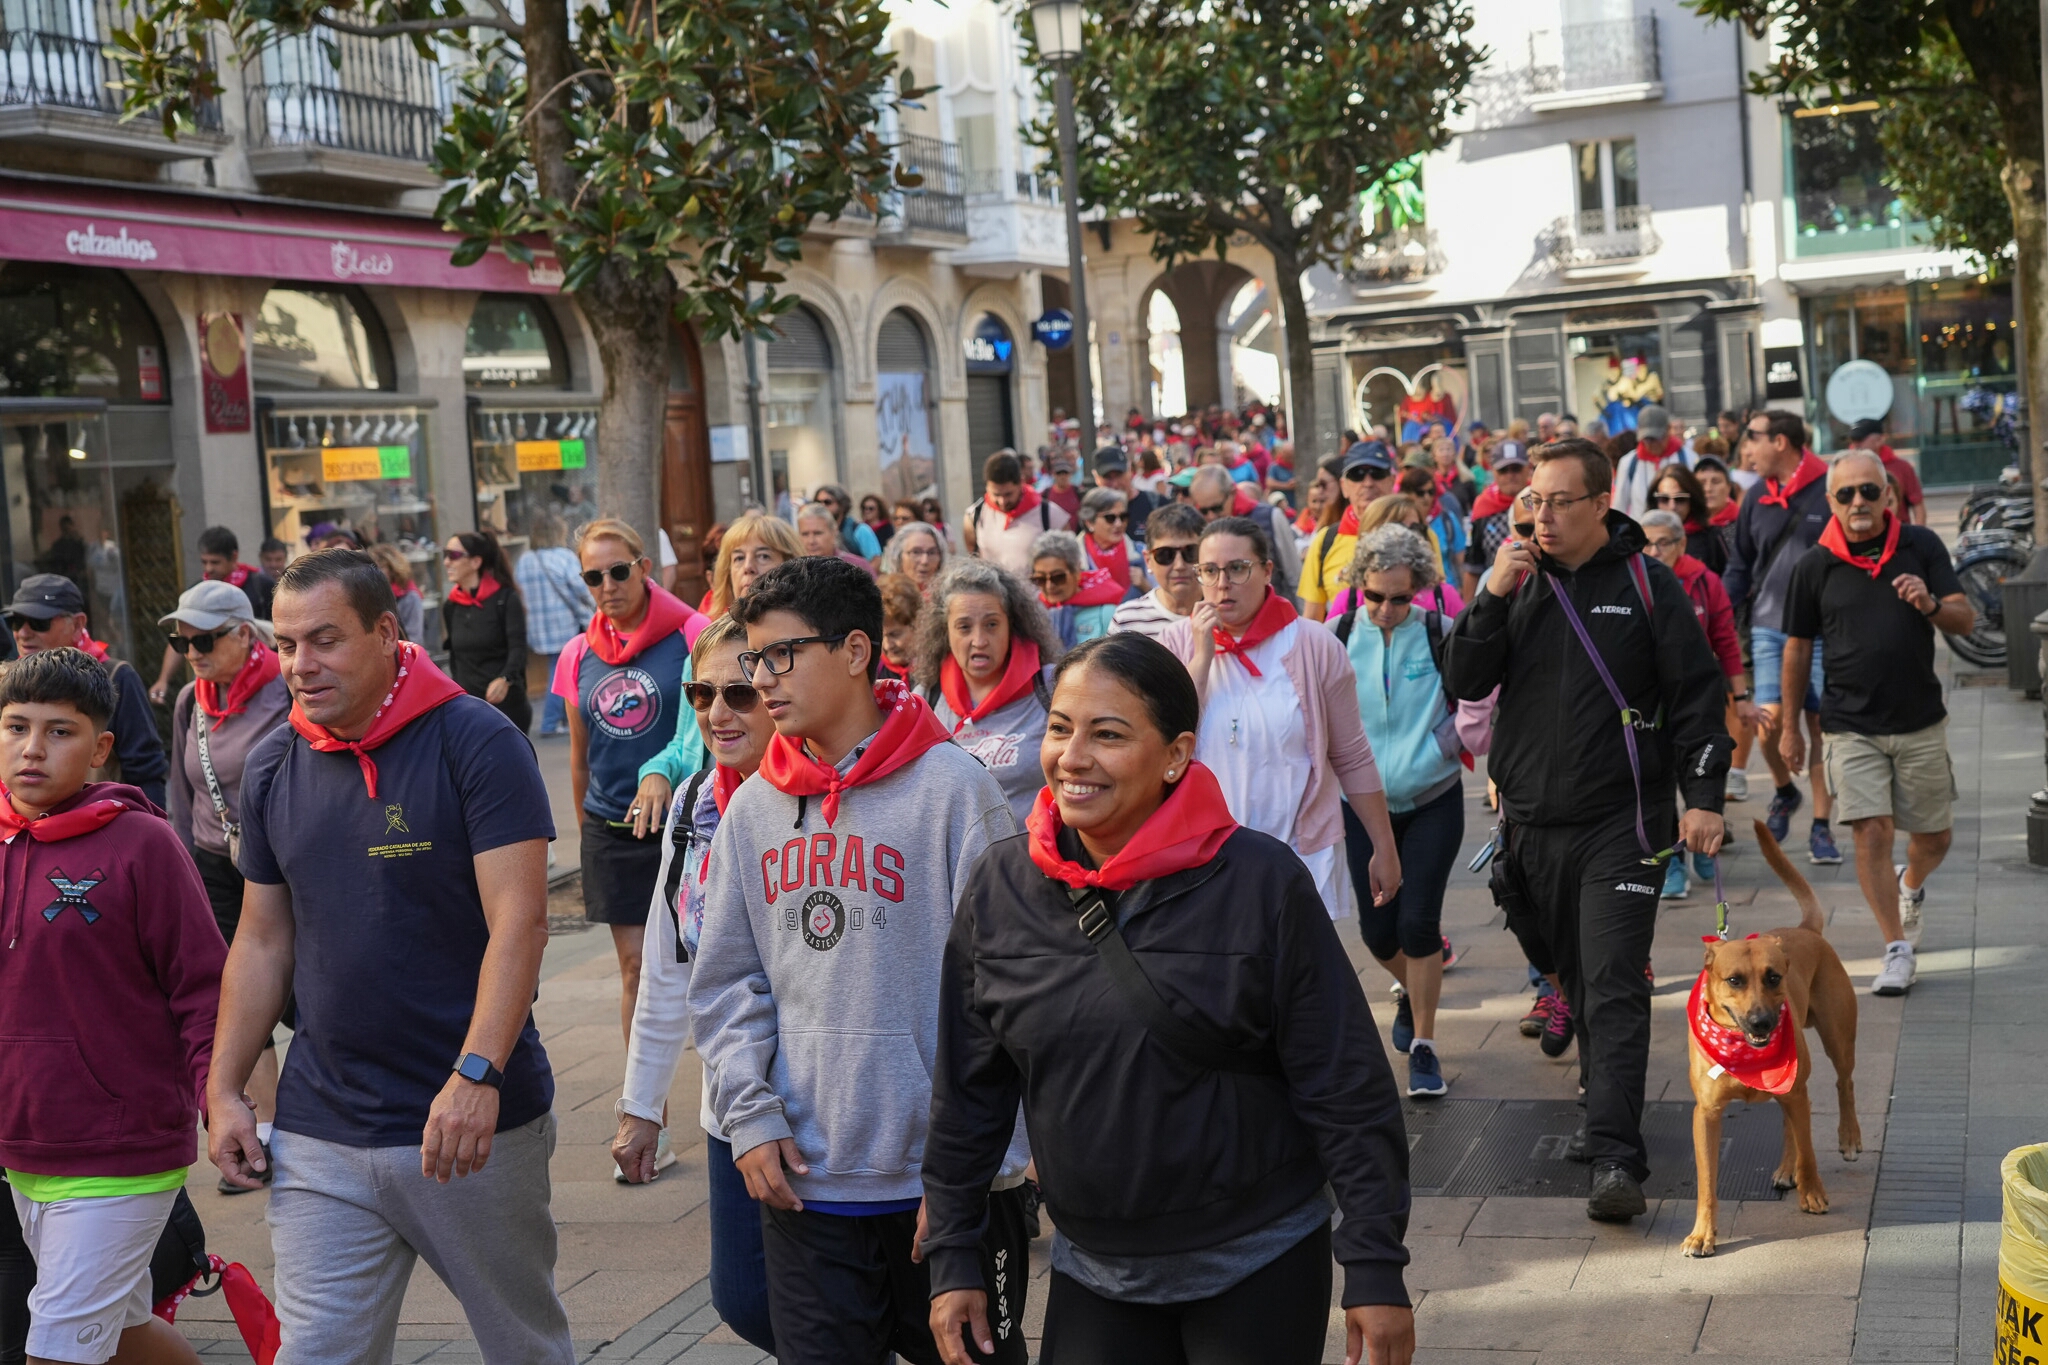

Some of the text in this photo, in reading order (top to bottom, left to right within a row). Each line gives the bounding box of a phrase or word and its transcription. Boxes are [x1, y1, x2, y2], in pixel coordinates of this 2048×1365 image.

[1602, 605, 1632, 615] TERREX
[627, 670, 655, 695] VITORIA
[599, 719, 632, 736] ZAPATILLAS
[761, 833, 904, 905] CORAS
[1626, 882, 1656, 895] TERREX
[805, 893, 840, 911] VITORIA
[804, 932, 840, 949] GASTEIZ
